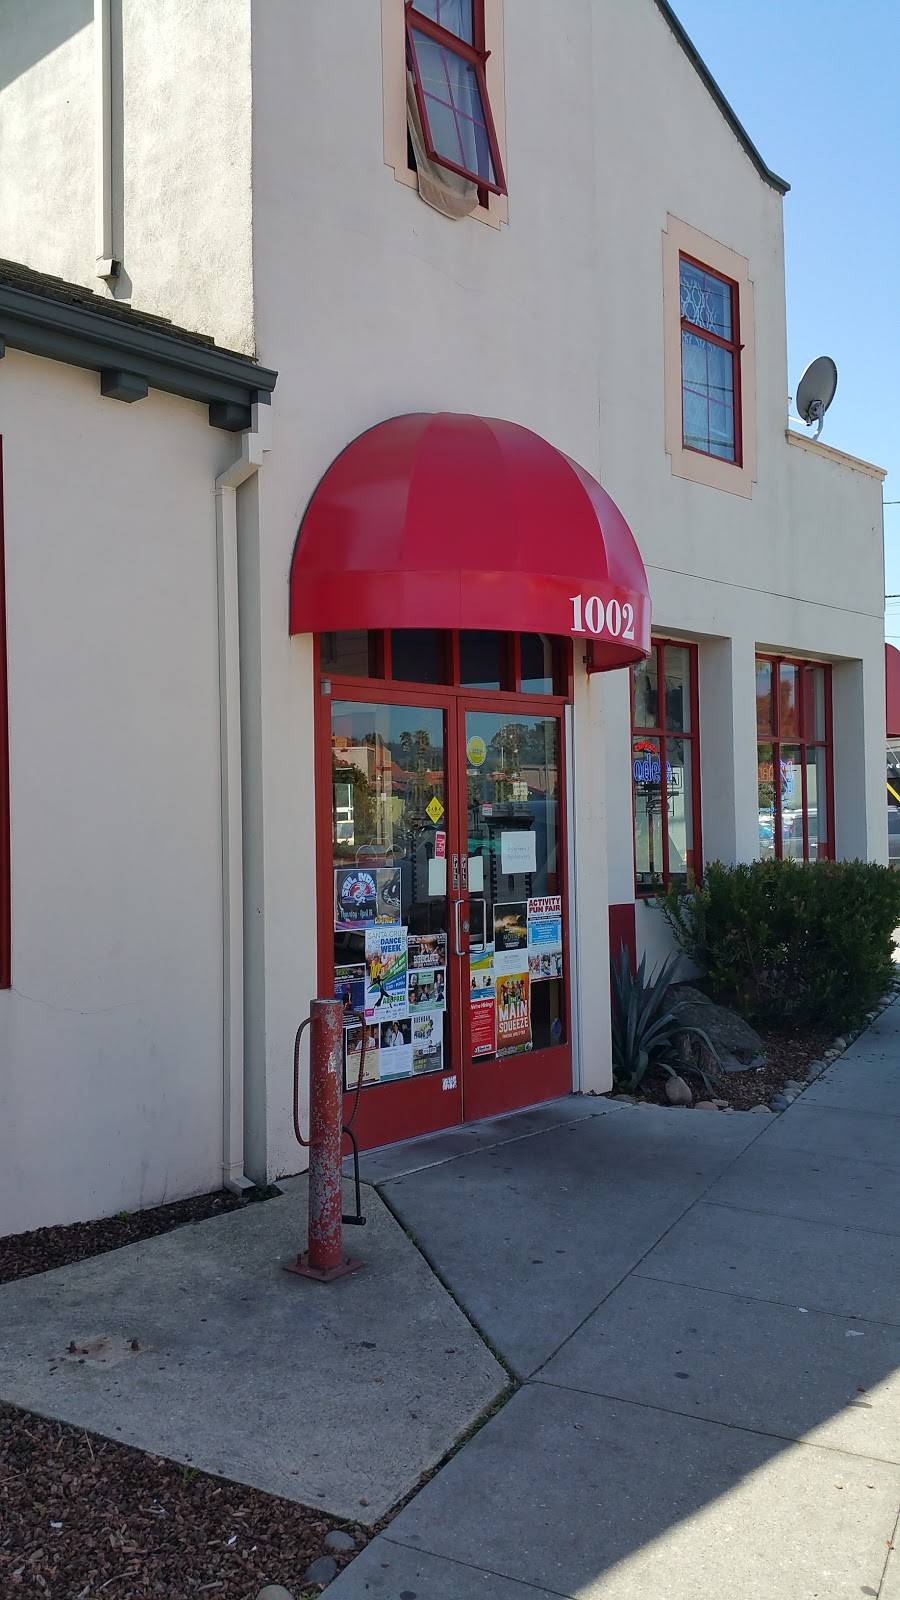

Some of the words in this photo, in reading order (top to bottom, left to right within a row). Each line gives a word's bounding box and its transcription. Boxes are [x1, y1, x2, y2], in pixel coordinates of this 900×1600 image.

[569, 594, 634, 640] 1002
[528, 897, 561, 907] ACTIVITY
[528, 906, 544, 914] FUN
[544, 904, 561, 913] FAIR
[368, 931, 388, 940] SANTA
[380, 937, 402, 945] DANCE
[380, 944, 402, 953] WEEK
[498, 1000, 528, 1021] MAIN
[498, 1017, 529, 1033] SQUEEZE
